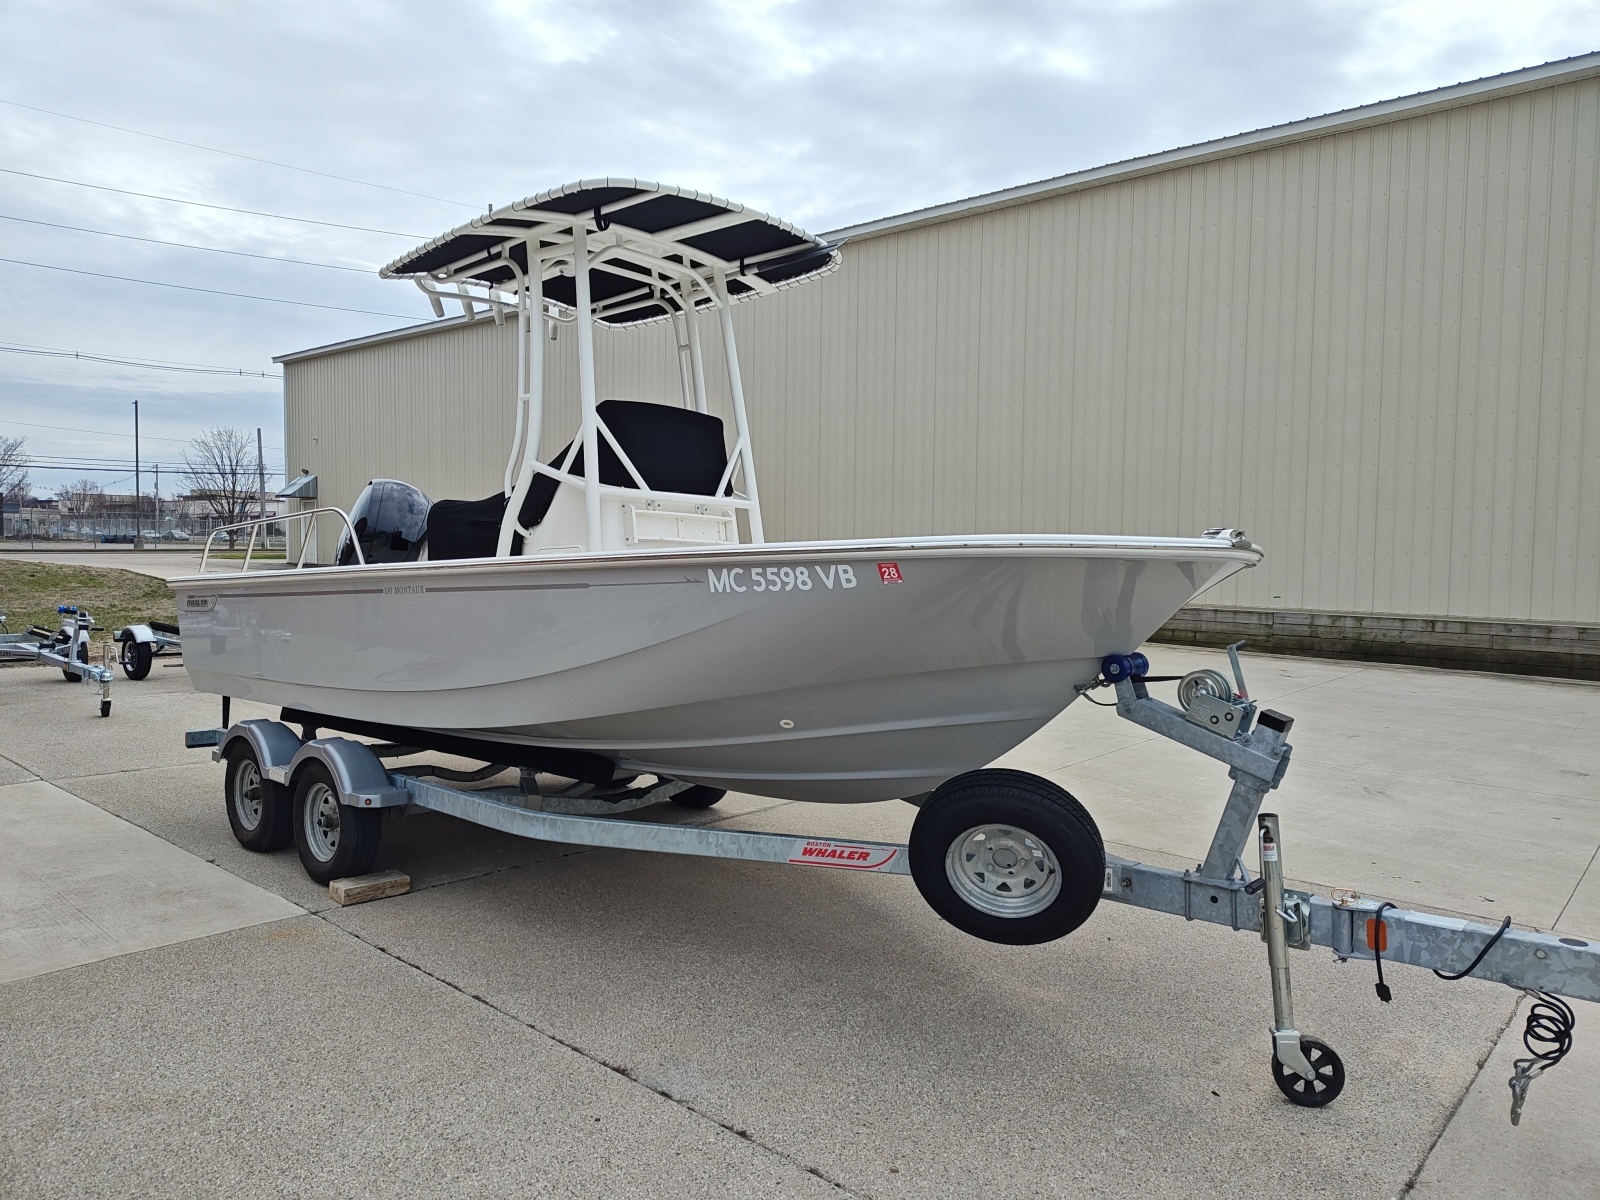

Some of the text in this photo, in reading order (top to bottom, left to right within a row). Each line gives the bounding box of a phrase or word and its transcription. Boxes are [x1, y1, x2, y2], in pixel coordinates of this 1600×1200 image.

[707, 565, 858, 593] MC 5598 VB
[881, 567, 898, 579] 28
[394, 585, 425, 595] MONTAUK
[802, 847, 871, 862] WHALER
